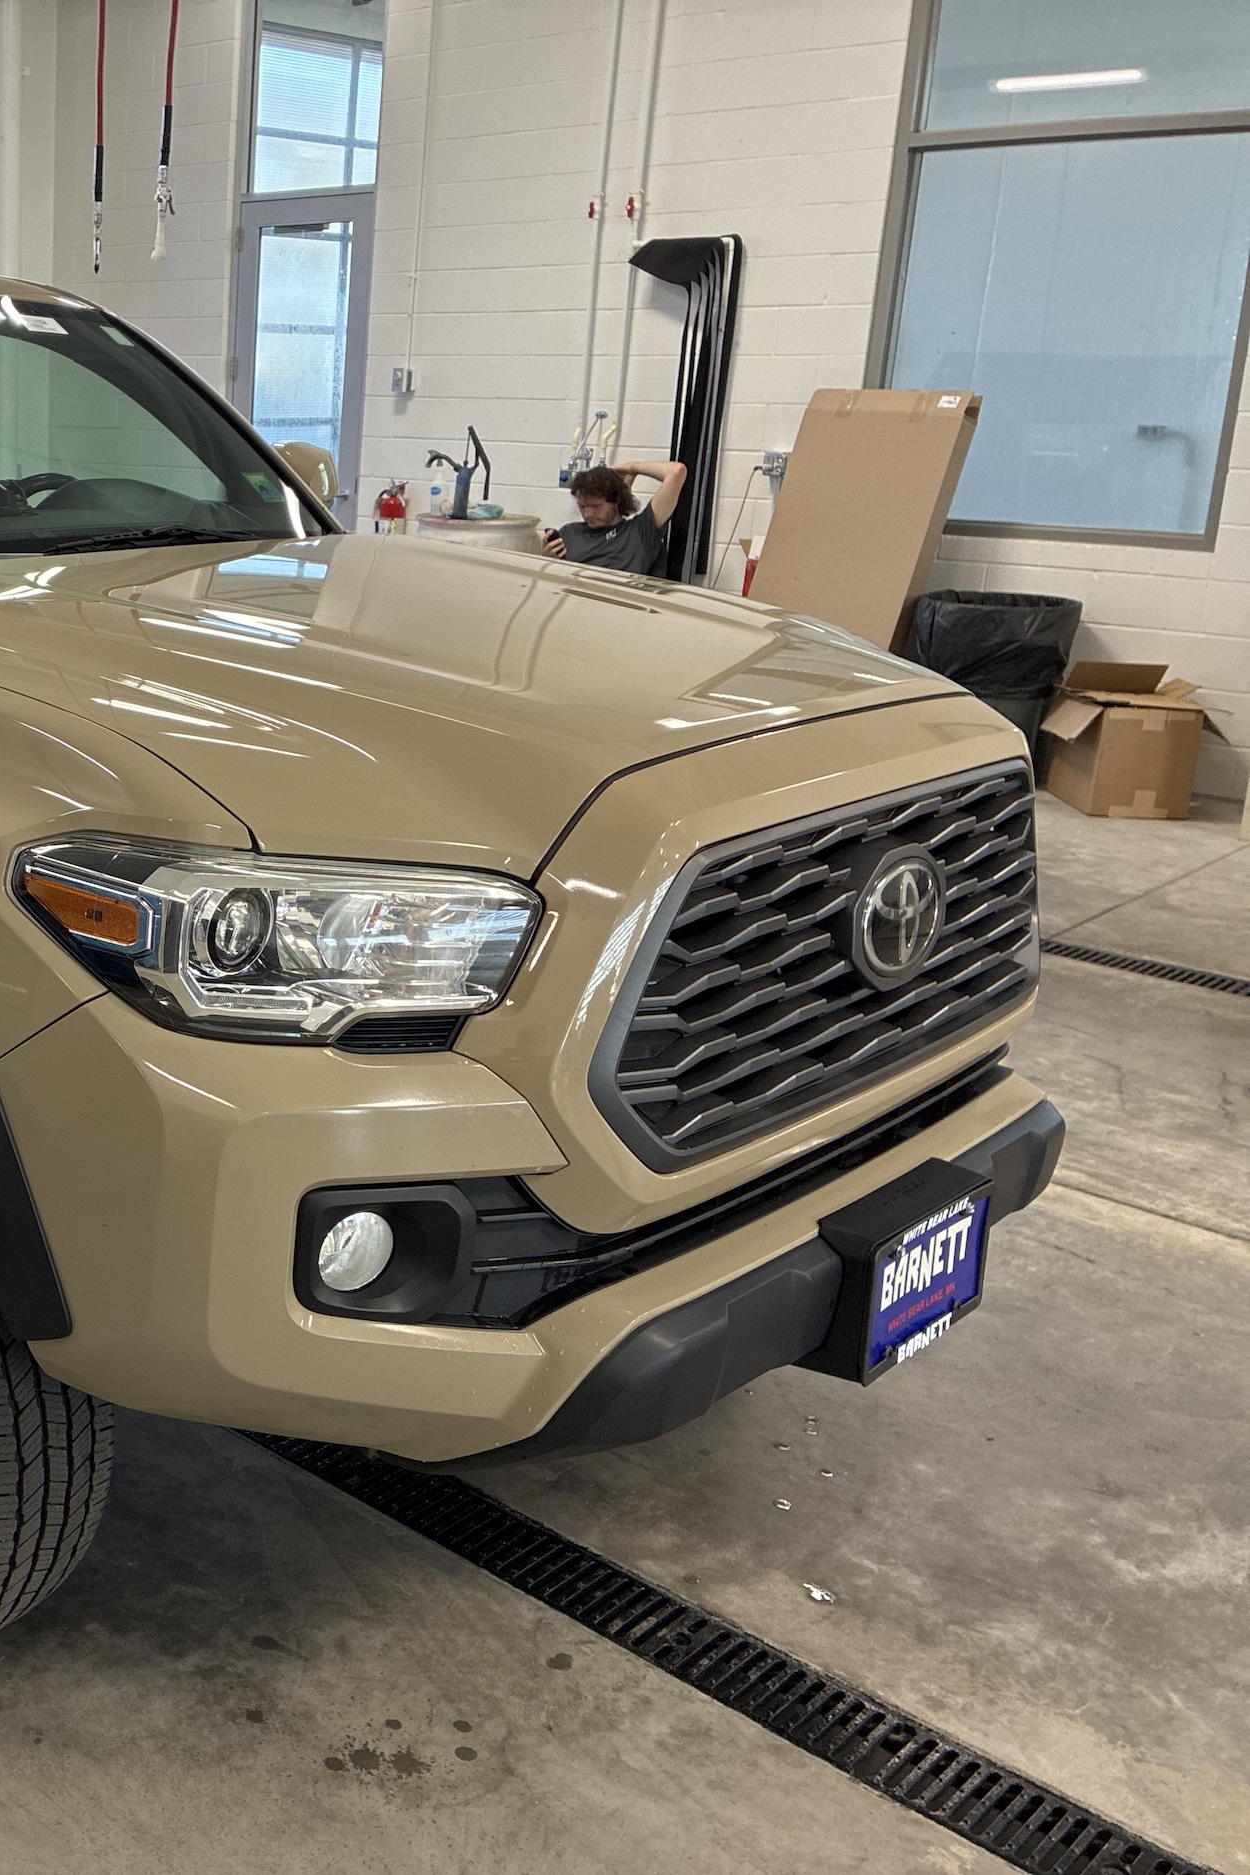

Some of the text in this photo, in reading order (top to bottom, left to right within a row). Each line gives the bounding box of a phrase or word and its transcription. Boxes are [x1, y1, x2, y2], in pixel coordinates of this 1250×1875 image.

[902, 1196, 969, 1246] WHITE BEAR LAKE
[880, 1215, 973, 1312] BARNETT
[888, 1311, 907, 1332] WHITE
[897, 1312, 953, 1364] BARNETT
